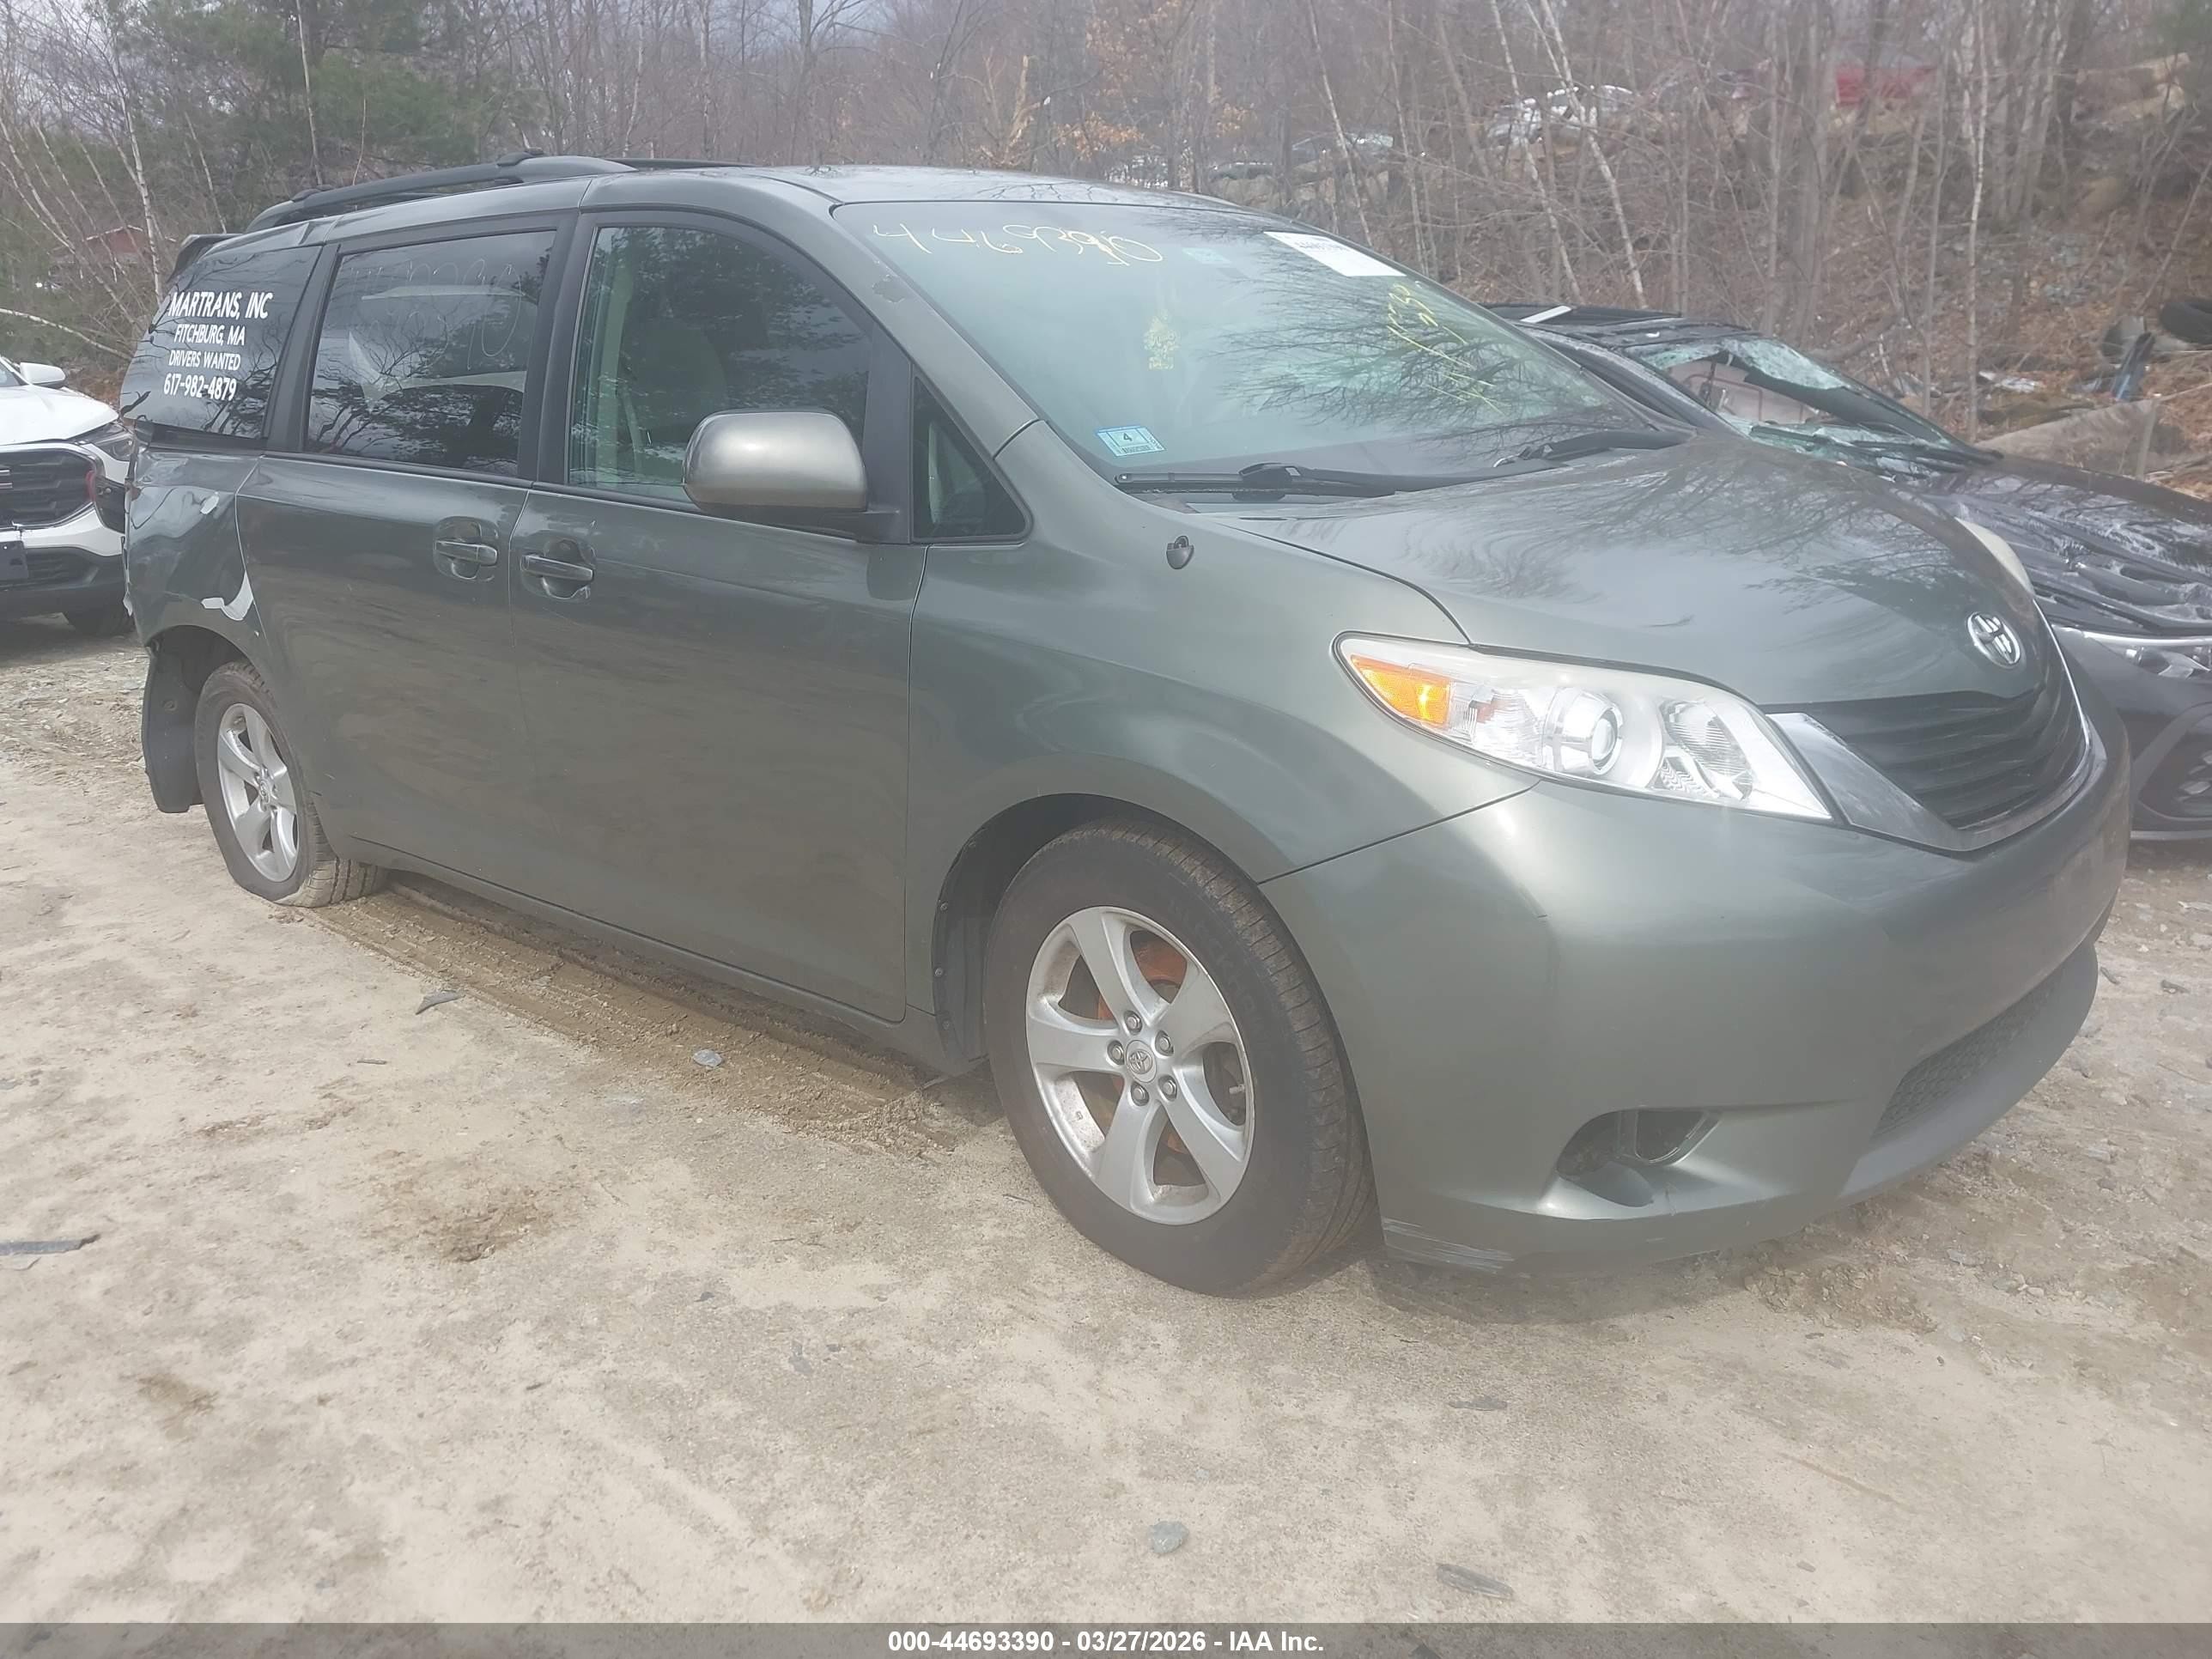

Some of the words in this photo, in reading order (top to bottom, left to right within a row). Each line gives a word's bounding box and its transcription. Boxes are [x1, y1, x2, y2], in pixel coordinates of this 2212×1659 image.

[167, 291, 243, 319] MARTRANS,
[245, 292, 273, 319] INC
[173, 324, 225, 346] FITCHBURG,
[227, 325, 246, 345] MA
[168, 349, 201, 368] DRIVERS
[203, 351, 241, 371] WANTED
[163, 373, 237, 401] 617-982-4879
